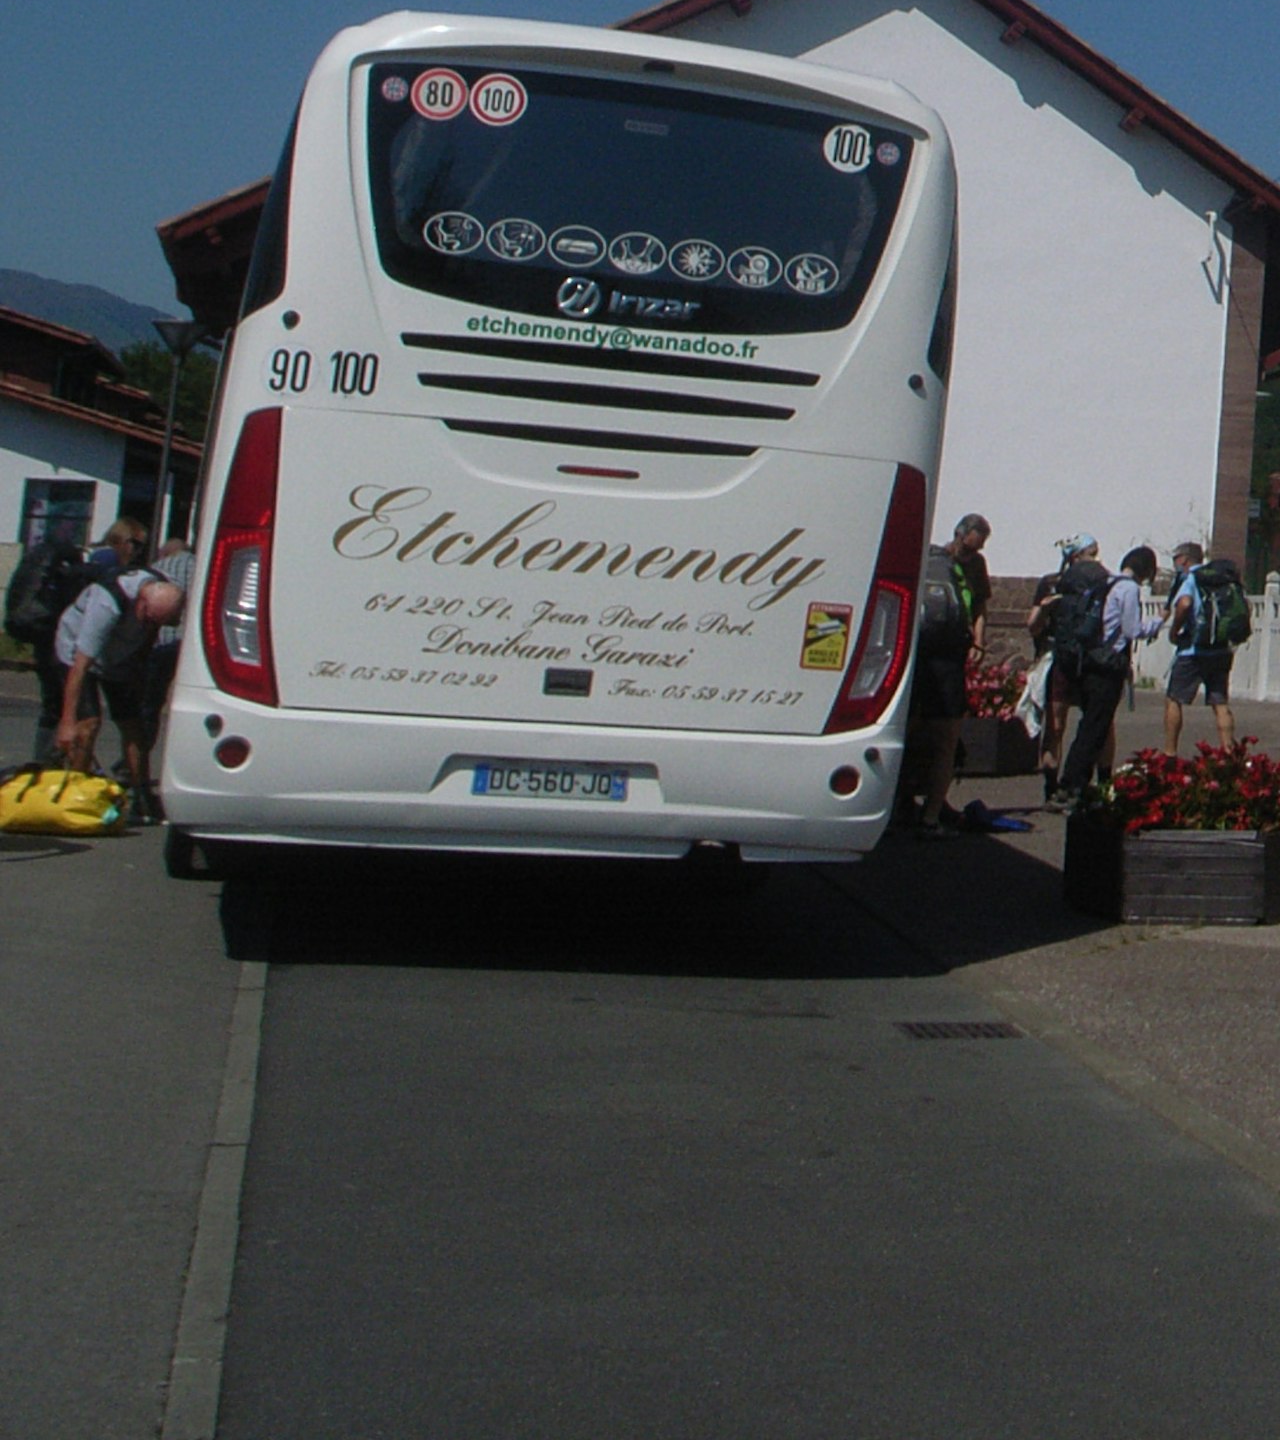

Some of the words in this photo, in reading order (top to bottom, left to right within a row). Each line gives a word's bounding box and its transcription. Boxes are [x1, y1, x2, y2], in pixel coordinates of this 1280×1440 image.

[426, 80, 454, 107] 80
[483, 88, 515, 113] 100
[833, 128, 867, 166] 100
[608, 290, 700, 319] Irizar
[467, 314, 759, 358] etchemendy@wanadoo.fr
[269, 348, 312, 393] 90
[330, 351, 379, 396] 100
[332, 484, 829, 612] Etchemendy
[405, 596, 464, 616] 220
[522, 599, 589, 628] Jean
[598, 605, 663, 631] Pied
[661, 613, 688, 632] de
[421, 624, 571, 661] Donibane
[581, 632, 695, 668] Garazi
[350, 666, 380, 681] 05
[661, 684, 691, 699] 05
[692, 686, 719, 701] 59
[721, 688, 749, 703] 37
[750, 689, 777, 704] 15
